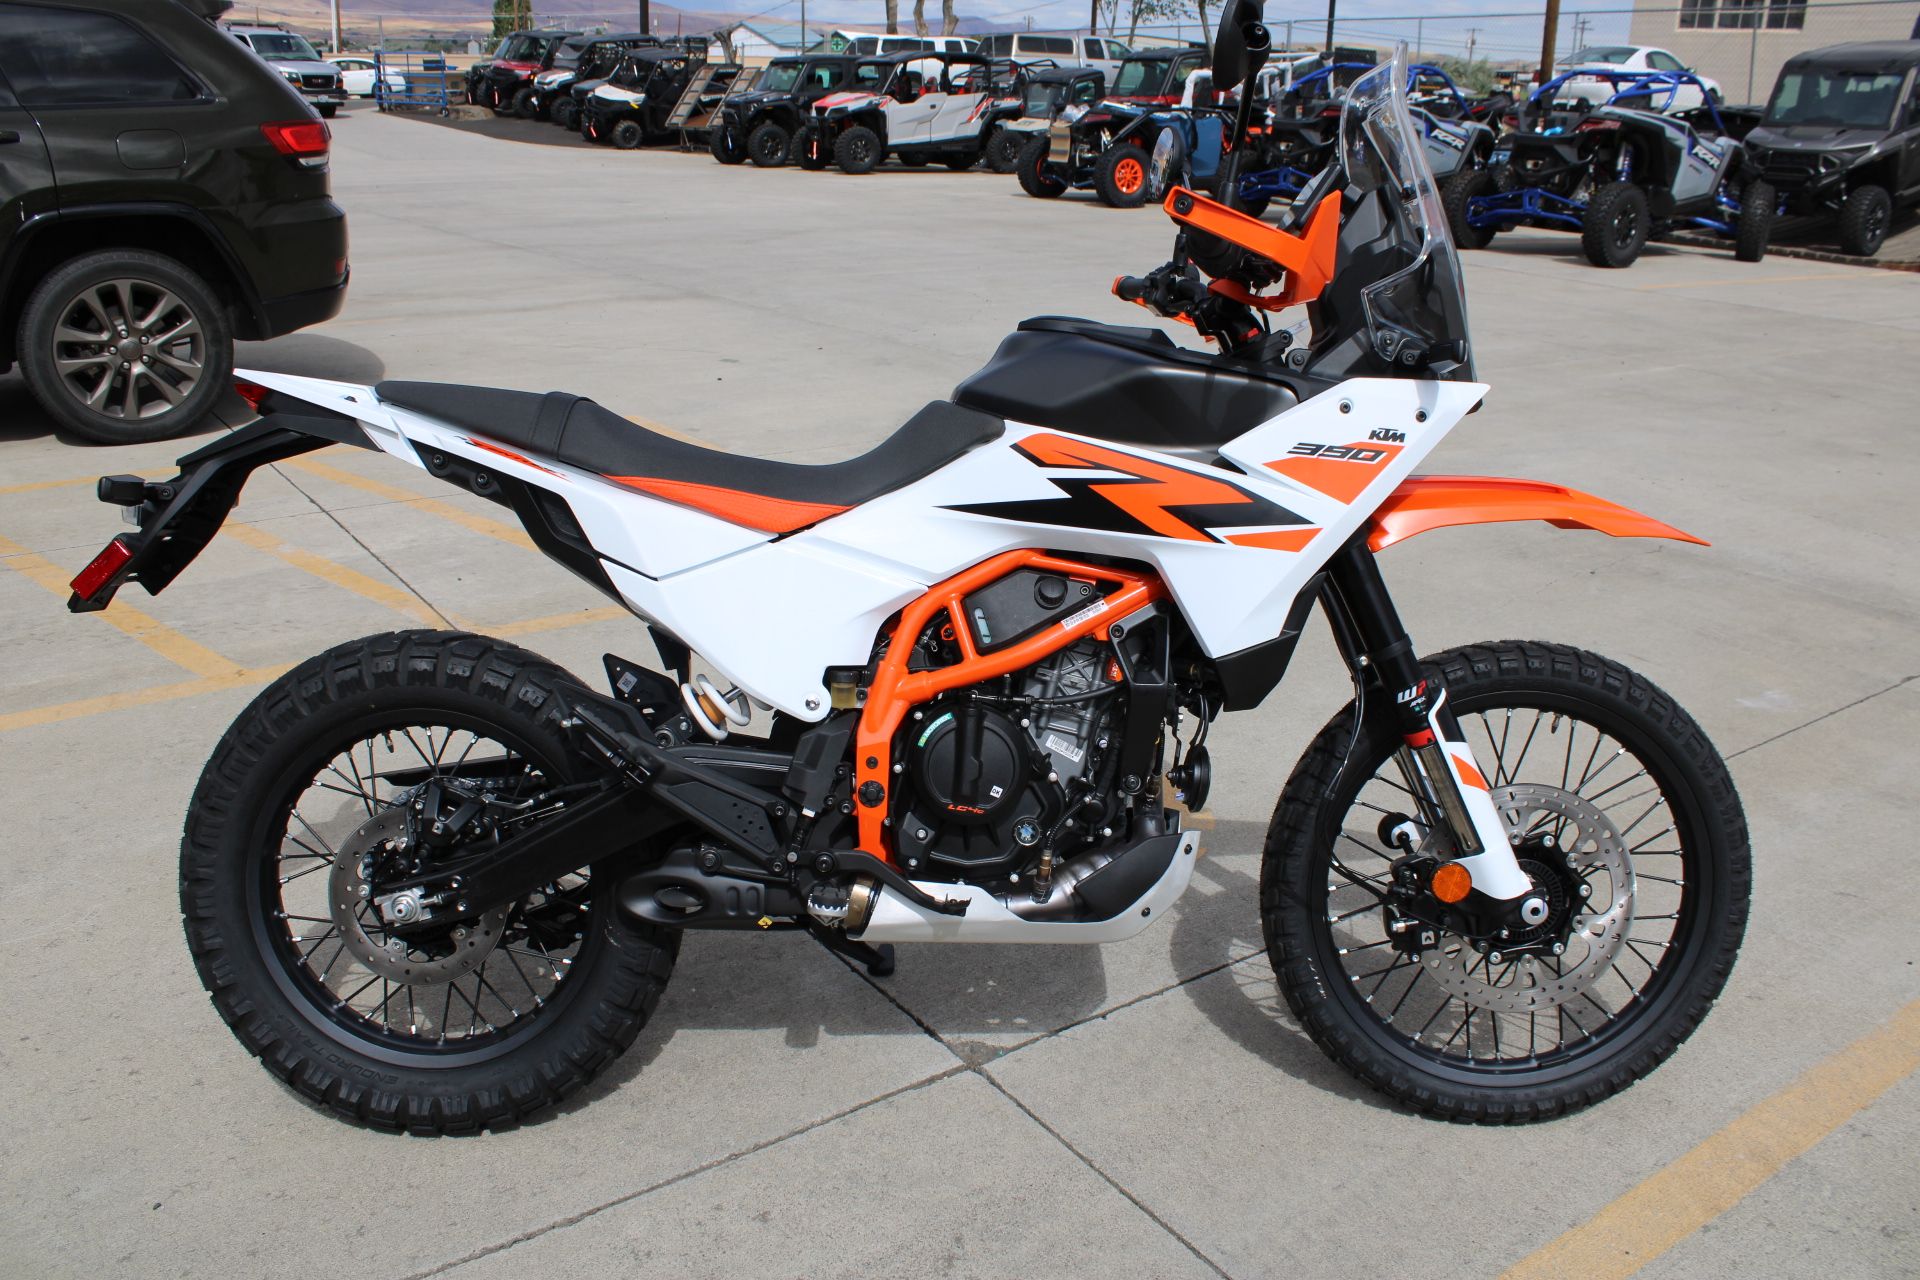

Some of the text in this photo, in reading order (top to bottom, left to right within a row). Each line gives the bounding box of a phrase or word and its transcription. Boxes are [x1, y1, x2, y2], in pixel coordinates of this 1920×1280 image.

[1430, 128, 1465, 149] RZR
[1691, 144, 1720, 169] RZR
[1368, 427, 1406, 443] KTM
[1287, 442, 1385, 462] 390
[1397, 679, 1427, 704] WP
[326, 1053, 400, 1085] ENDURO
